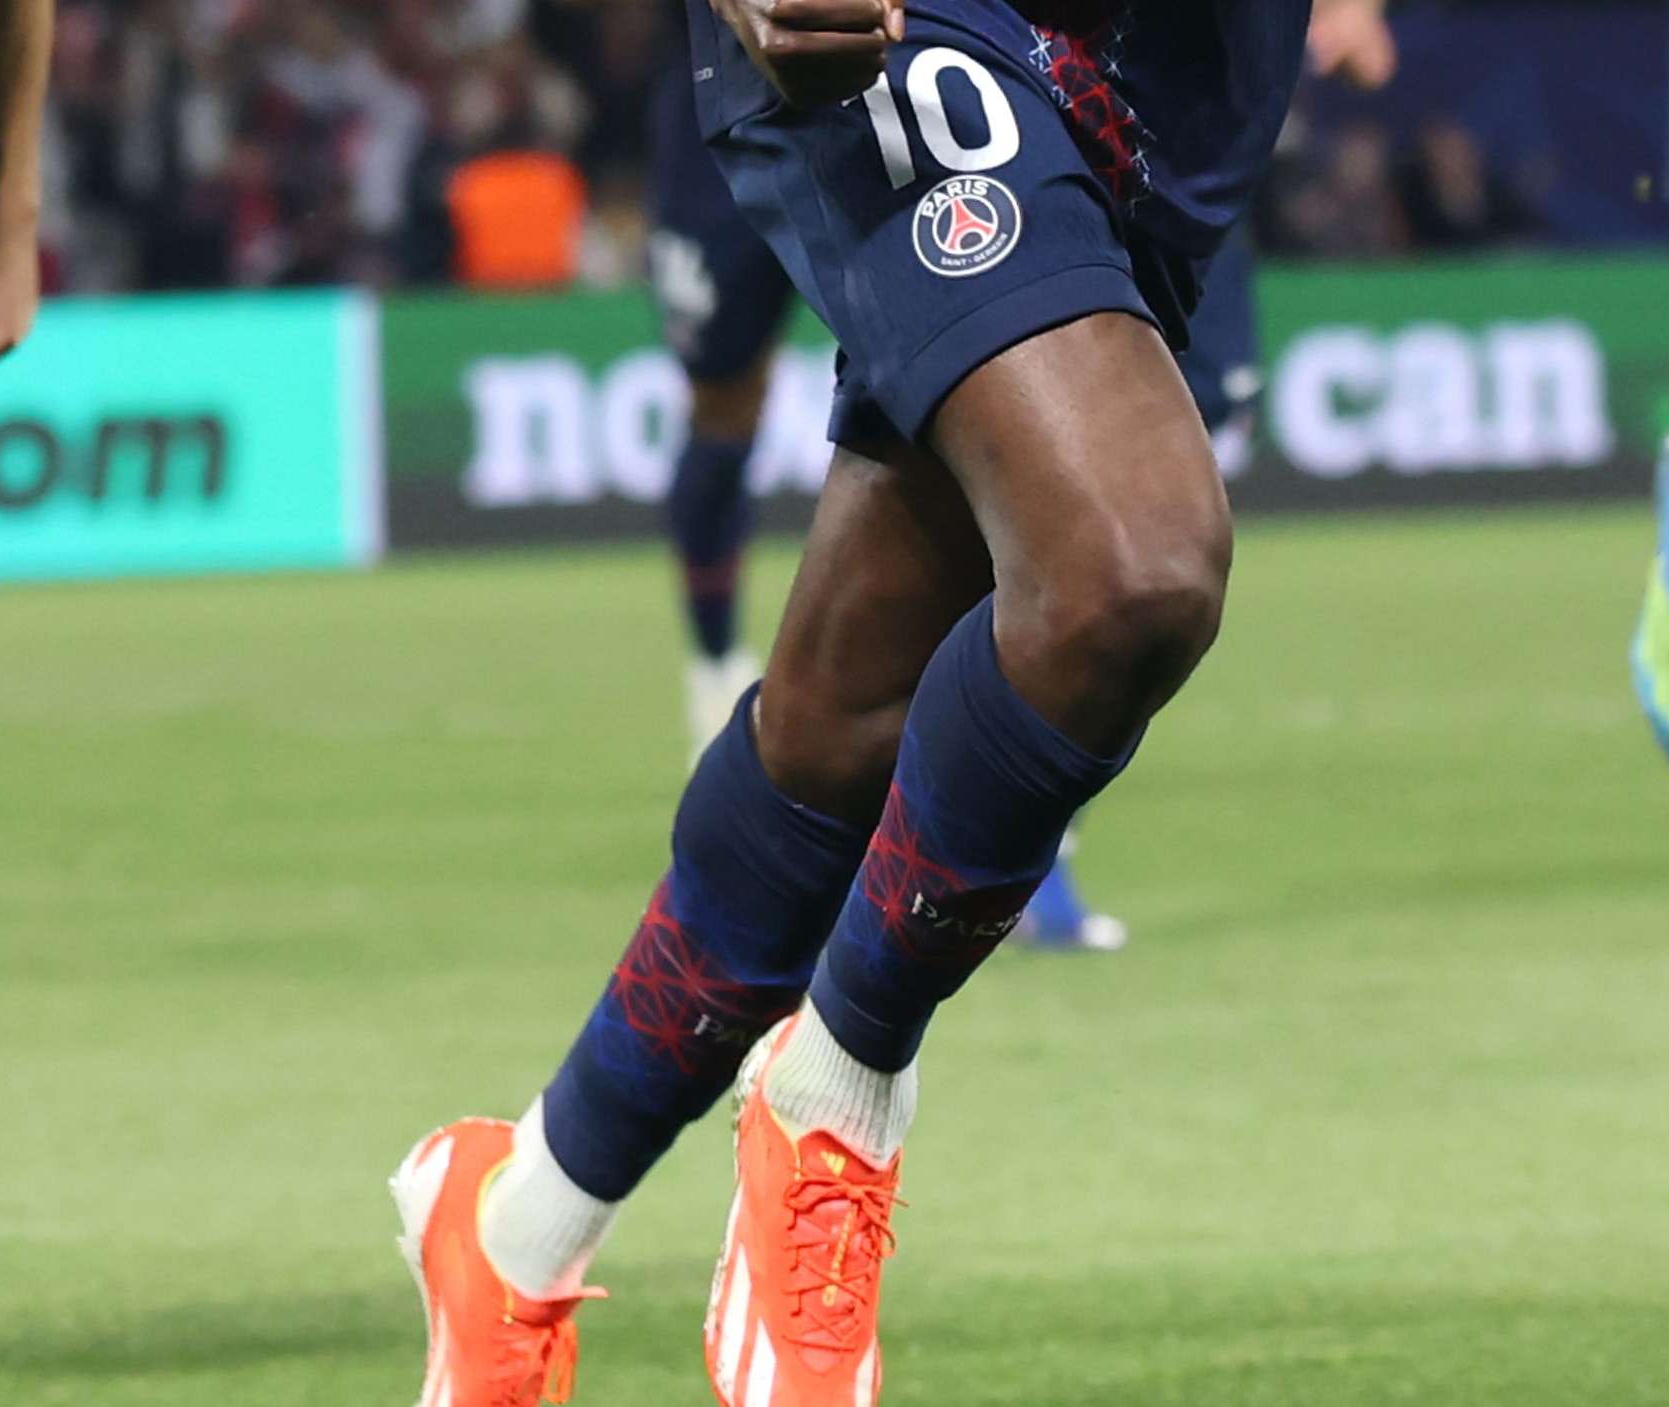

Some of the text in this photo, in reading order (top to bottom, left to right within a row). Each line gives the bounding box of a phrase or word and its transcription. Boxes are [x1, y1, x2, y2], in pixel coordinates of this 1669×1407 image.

[842, 47, 1020, 190] 10
[921, 180, 989, 218] PARIS
[1272, 322, 1613, 477] can
